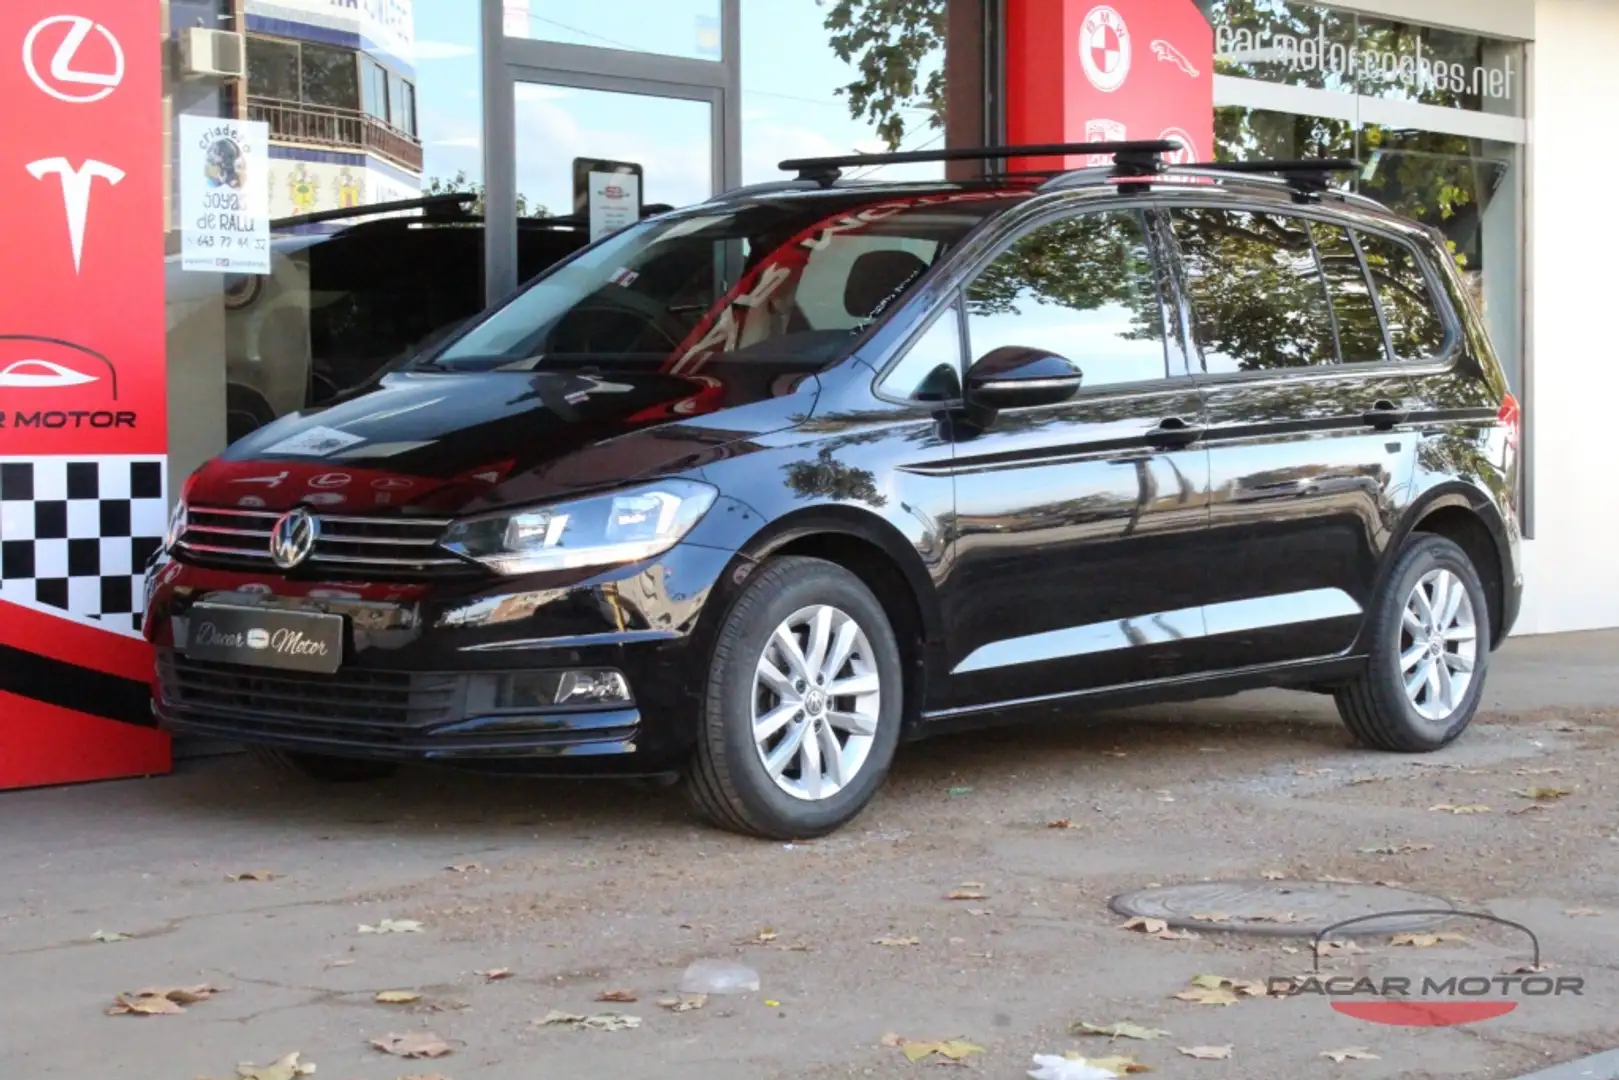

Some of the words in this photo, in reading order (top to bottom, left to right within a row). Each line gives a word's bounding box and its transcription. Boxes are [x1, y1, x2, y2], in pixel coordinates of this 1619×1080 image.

[196, 213, 216, 230] de
[14, 410, 137, 429] MOTOR
[271, 627, 329, 657] Motor
